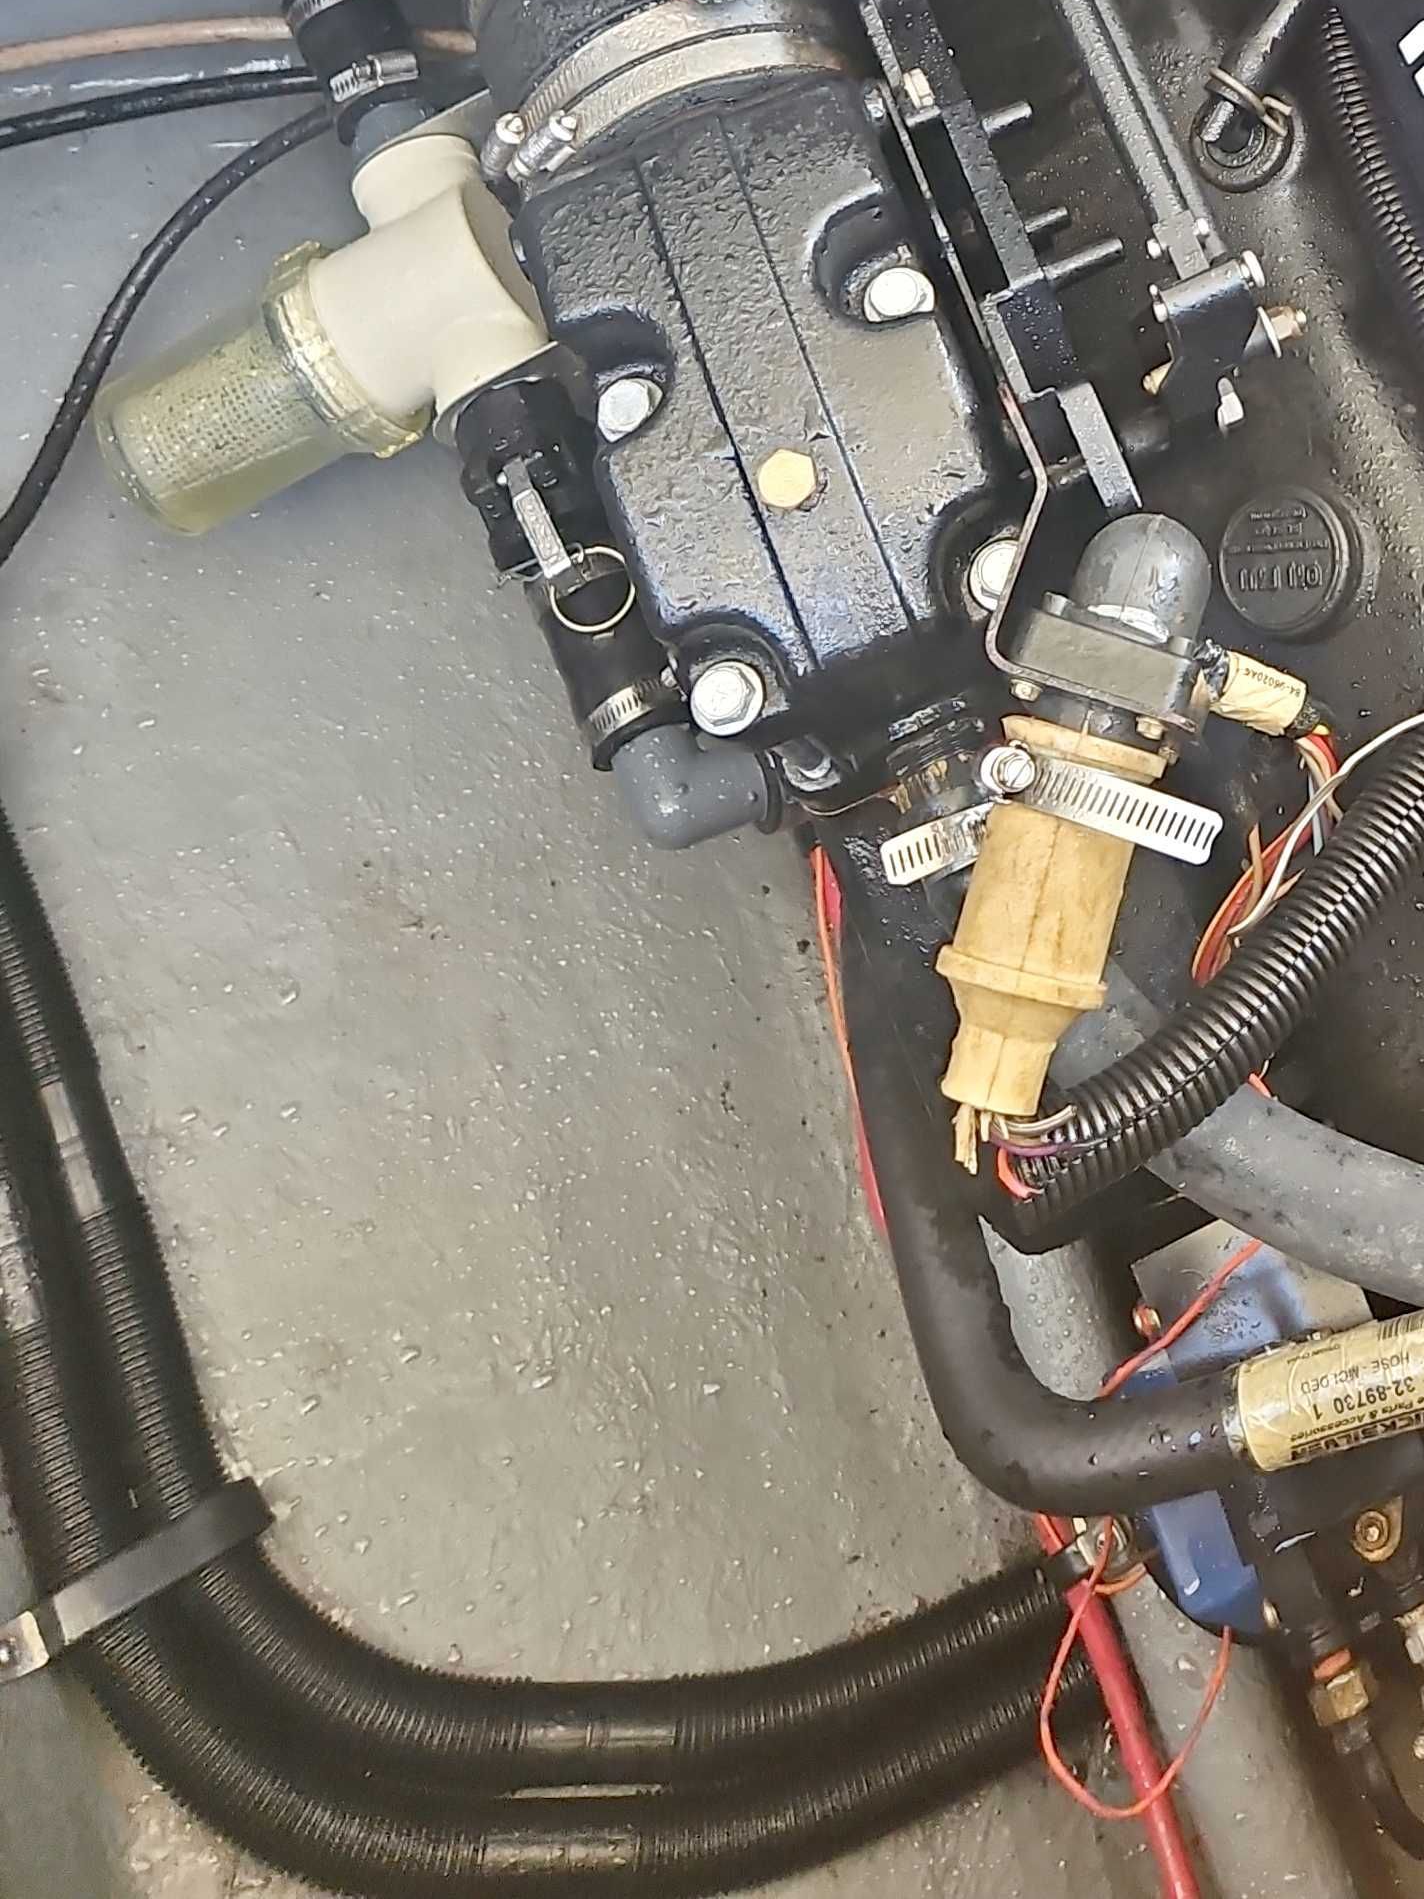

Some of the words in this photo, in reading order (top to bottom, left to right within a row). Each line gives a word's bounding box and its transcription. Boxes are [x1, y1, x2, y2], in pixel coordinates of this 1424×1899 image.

[1369, 1351, 1410, 1373] HOSE
[1331, 1375, 1416, 1414] 32-89730
[1310, 1402, 1323, 1420] 1
[1367, 1409, 1378, 1420] &
[1380, 1398, 1414, 1416] Parts
[1288, 1412, 1366, 1443] Accessories
